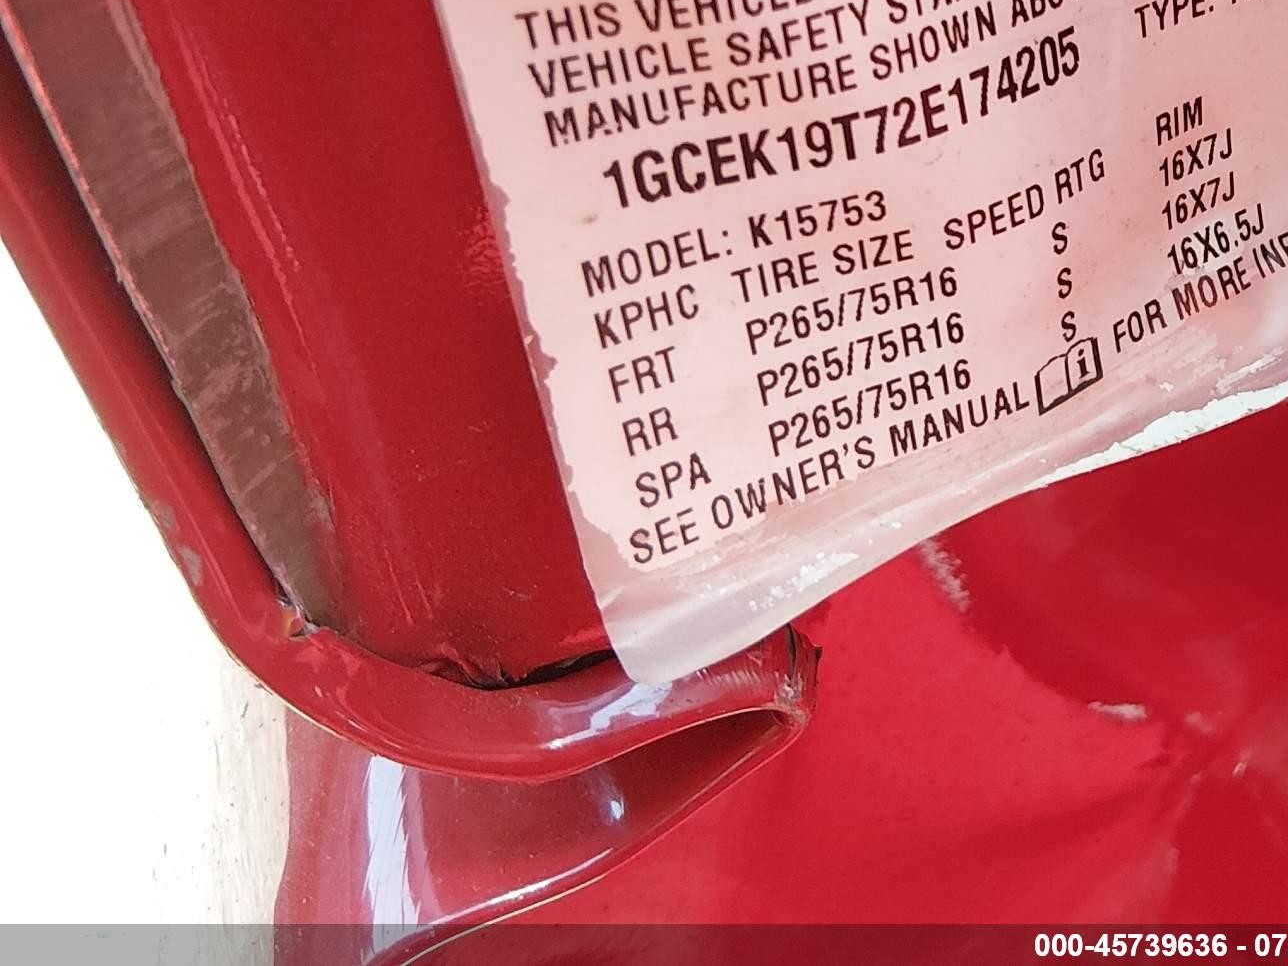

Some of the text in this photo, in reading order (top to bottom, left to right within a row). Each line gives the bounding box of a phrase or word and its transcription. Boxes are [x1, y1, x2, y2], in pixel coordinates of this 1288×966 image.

[514, 1, 622, 51] THIS
[527, 37, 713, 99] VEHICLE
[543, 53, 858, 148] MANUFACTURE
[869, 0, 998, 81] SHOWN
[602, 25, 1080, 209] 1GCEK19T72E174205
[580, 189, 887, 298] MODEL: K15753
[593, 283, 699, 350] KPHC
[730, 250, 820, 303] TIRE
[832, 228, 915, 276] SIZE
[943, 183, 1045, 251] SPEED
[1054, 148, 1105, 205] RTG
[1155, 95, 1203, 147] RIM
[607, 345, 675, 404] FRT
[745, 266, 958, 356] P265/75R16
[1050, 221, 1070, 256] S
[1158, 127, 1233, 187] 16X7J
[621, 406, 679, 457] RR
[756, 311, 965, 407] P265/75R16
[1056, 266, 1073, 300] S
[1161, 170, 1235, 231] 16X7J
[629, 507, 700, 564] SEE
[710, 435, 876, 530] OWNER'S
[888, 381, 1031, 458] MANUAL
[1112, 298, 1168, 354] FOR
[1169, 255, 1252, 321] MORE
[635, 451, 712, 509] SPA
[767, 358, 972, 458] P265/75R16
[1060, 310, 1077, 344] S
[1166, 202, 1265, 279] 16X6.5J
